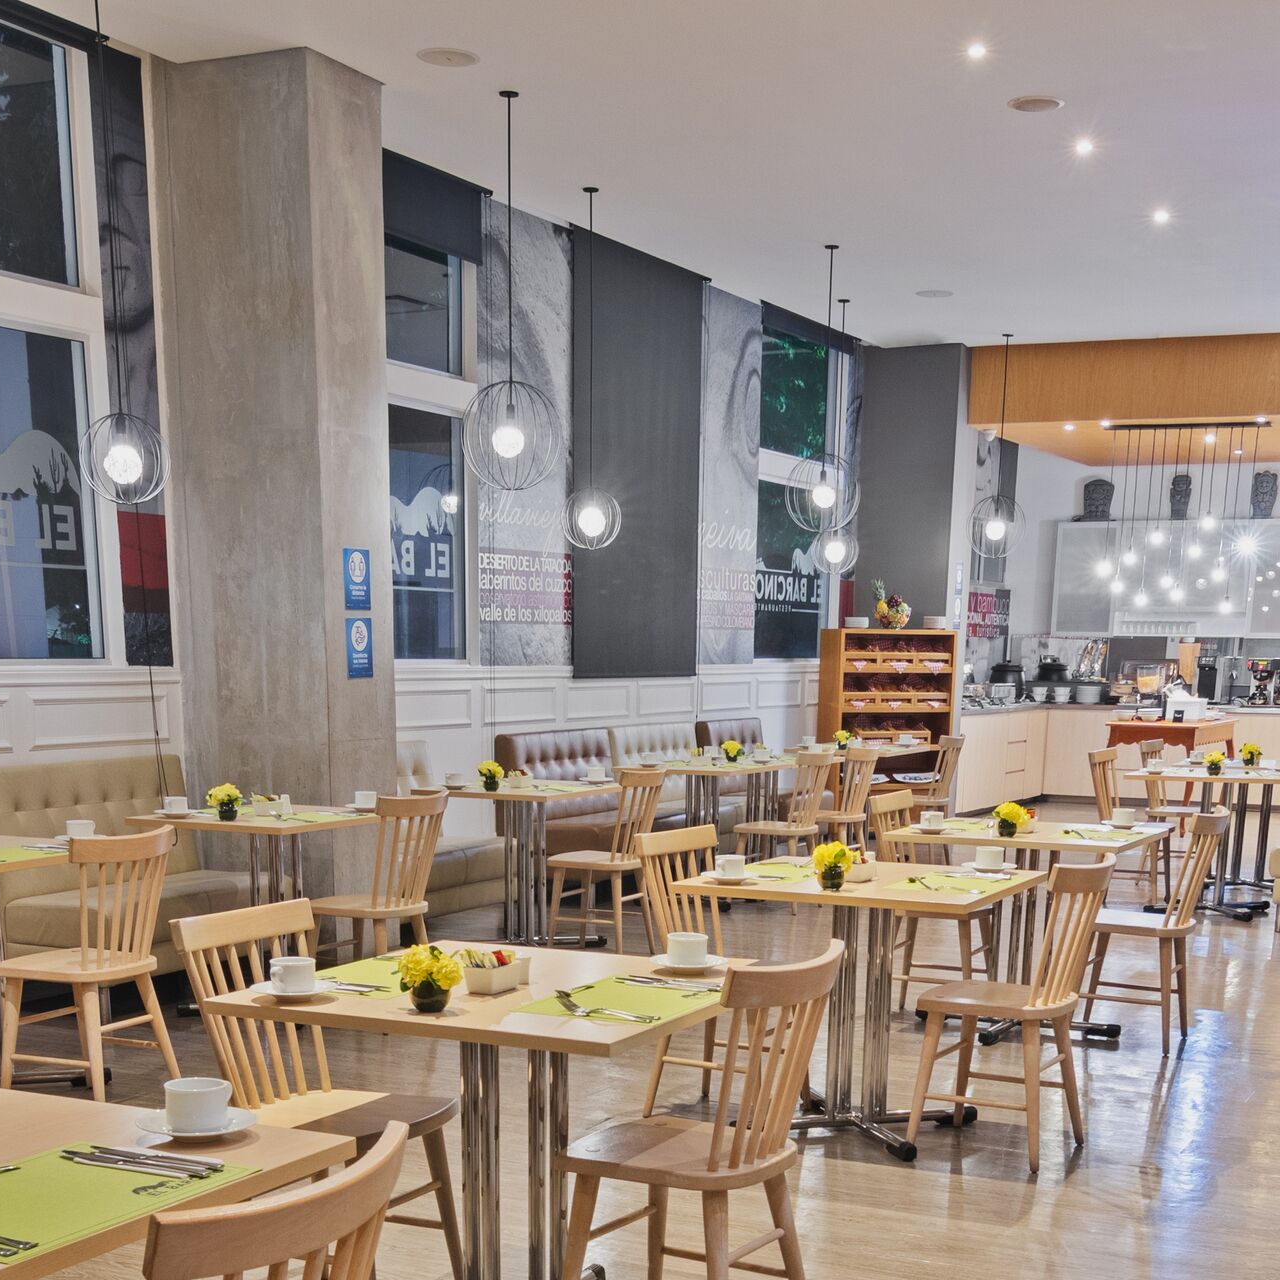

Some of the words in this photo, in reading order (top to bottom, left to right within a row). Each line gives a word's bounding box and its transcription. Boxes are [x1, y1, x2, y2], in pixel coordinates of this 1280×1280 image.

[479, 569, 527, 591] laberintos
[529, 573, 543, 592] del
[480, 603, 501, 621] valle
[504, 604, 516, 621] de
[518, 606, 532, 622] los
